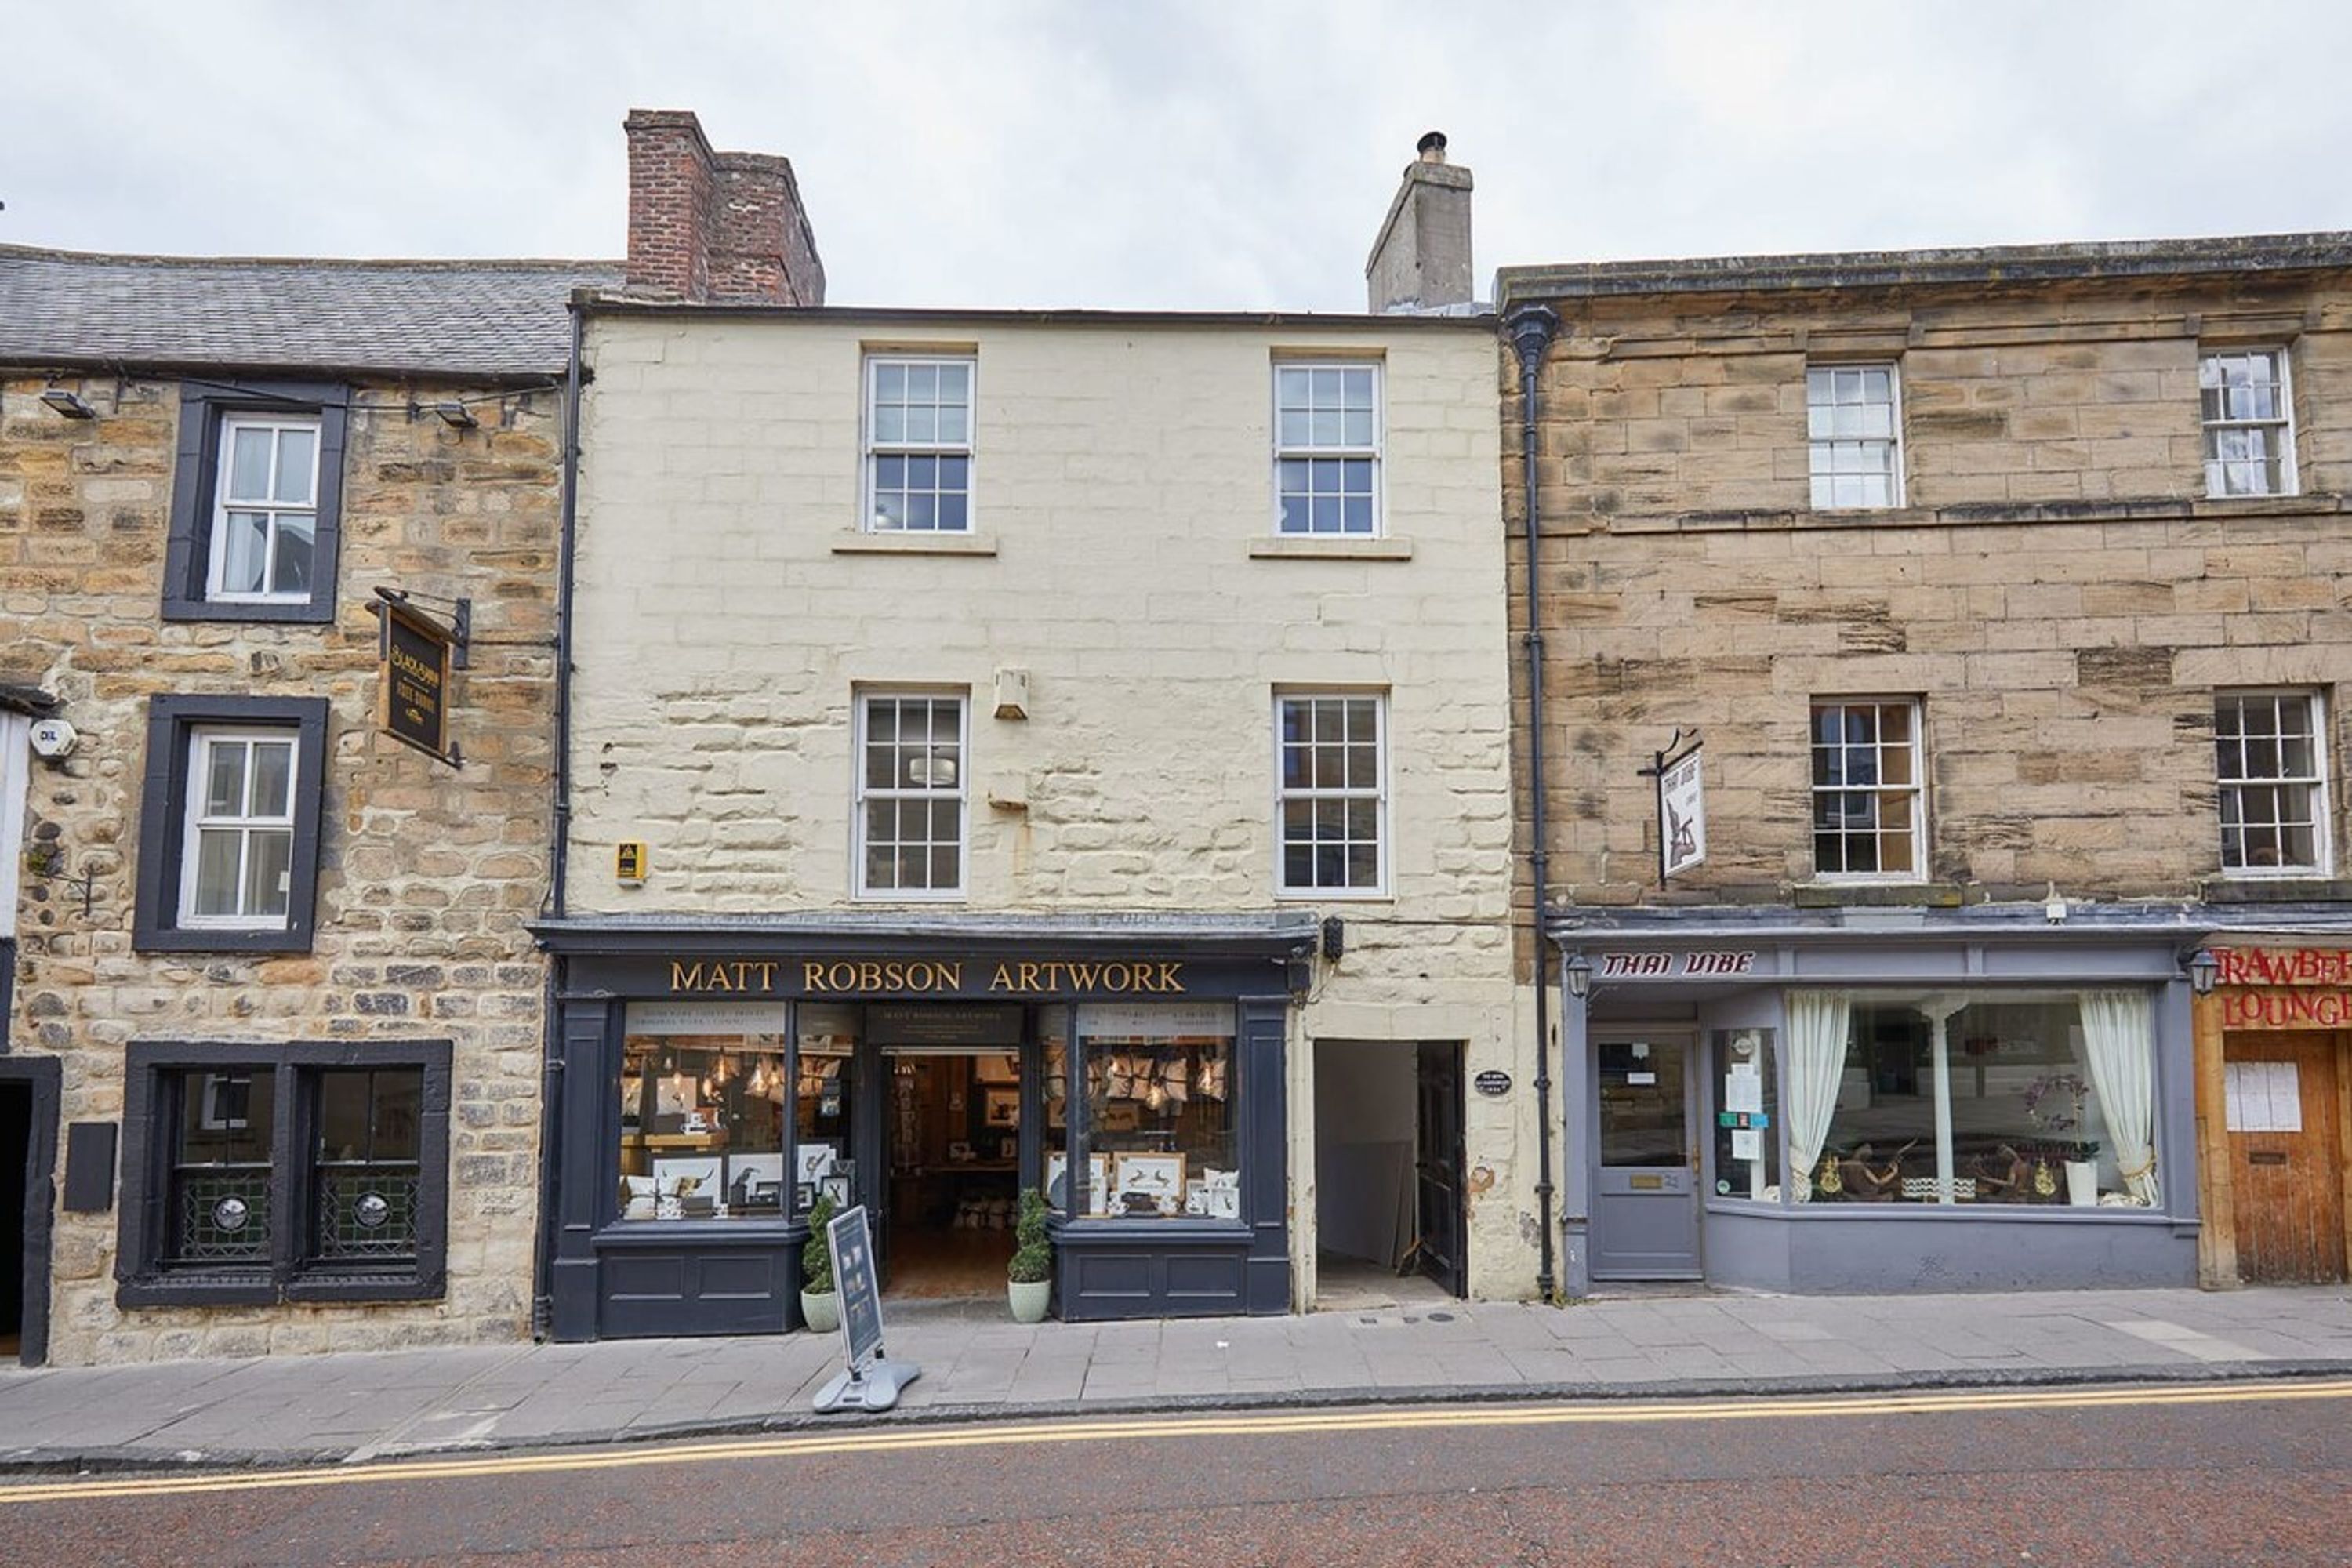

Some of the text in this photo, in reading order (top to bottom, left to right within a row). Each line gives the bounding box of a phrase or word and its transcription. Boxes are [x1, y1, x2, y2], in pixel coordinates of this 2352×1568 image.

[670, 961, 1186, 992] MATT ROBSON ARTWORK
[1603, 952, 1755, 976] THAI VIBE
